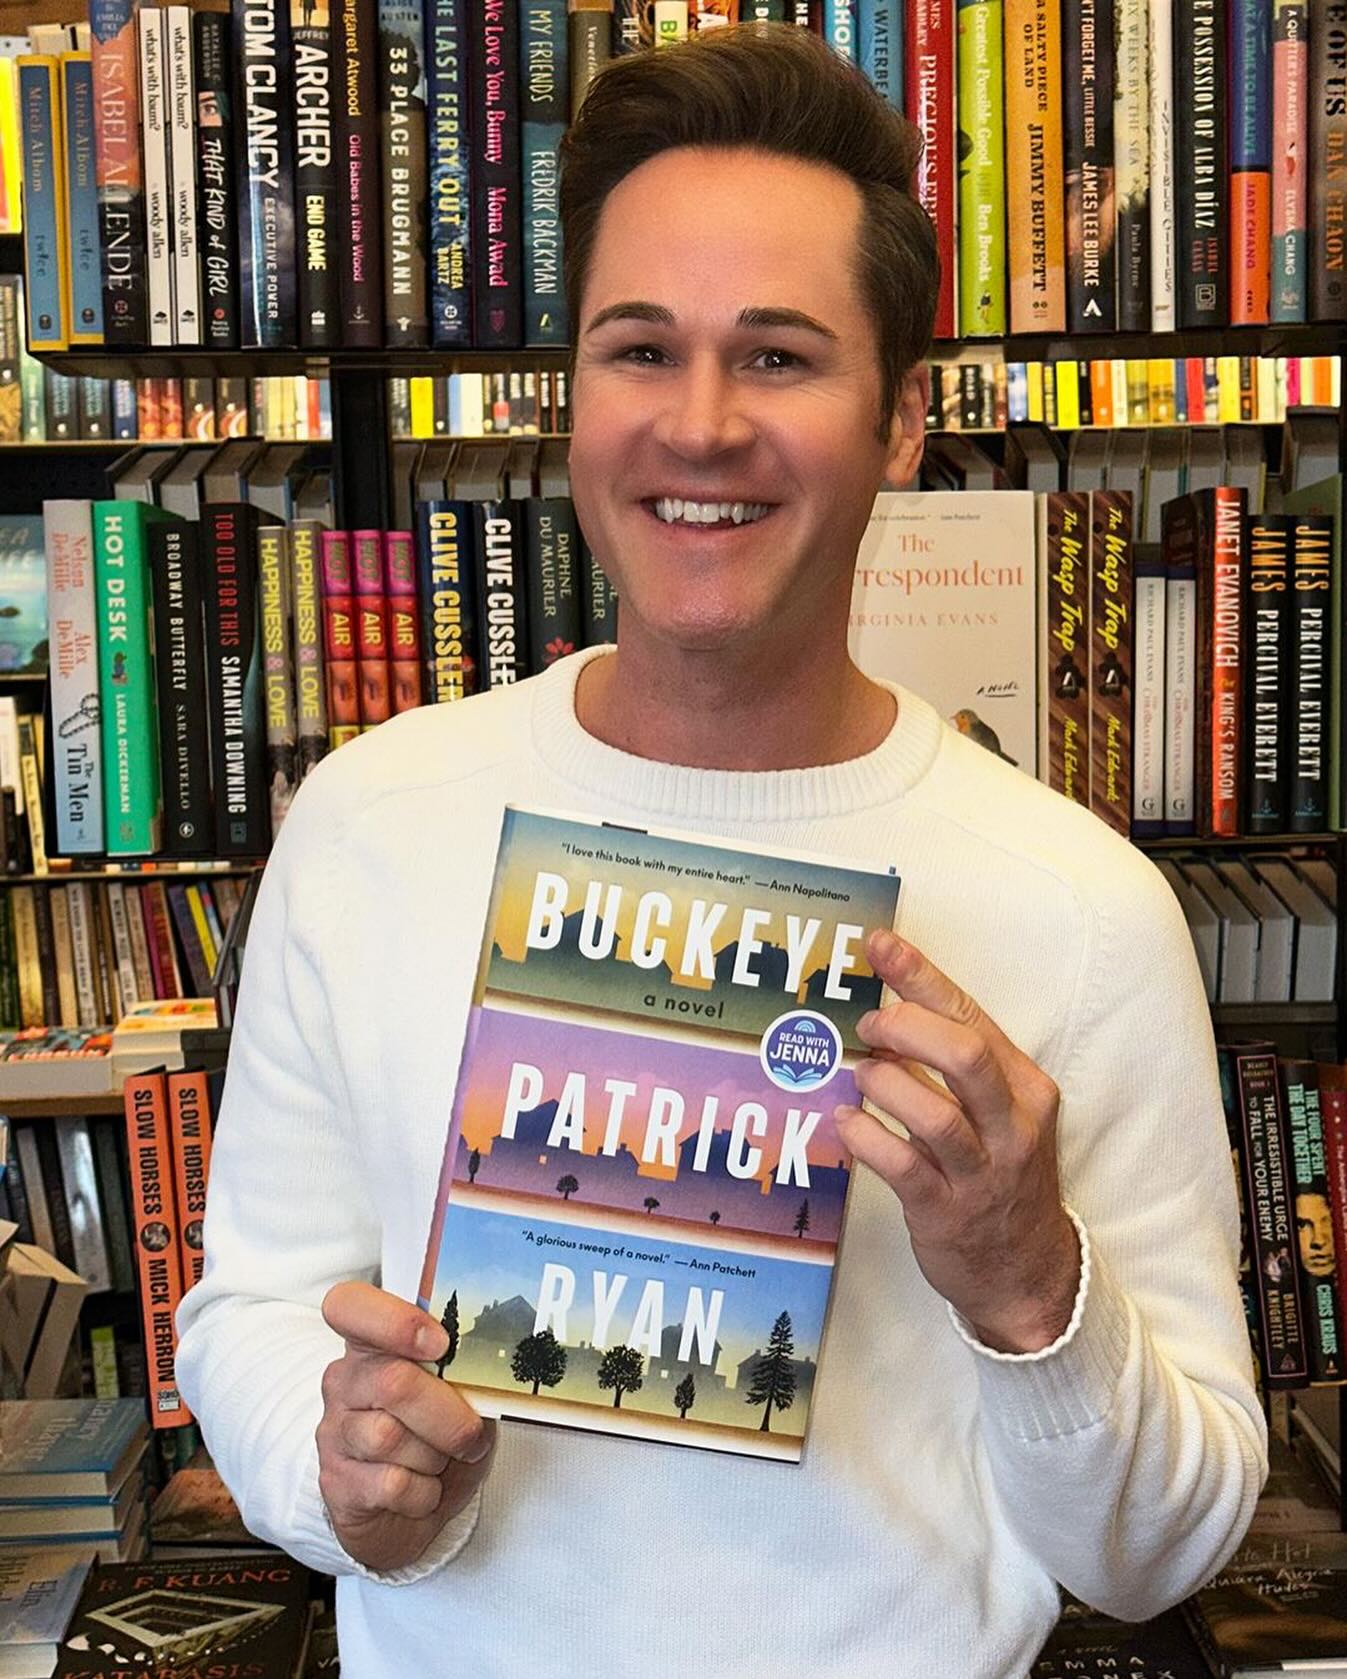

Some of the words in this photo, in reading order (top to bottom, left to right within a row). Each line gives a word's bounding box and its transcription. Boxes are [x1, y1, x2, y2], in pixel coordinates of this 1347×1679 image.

[245, 0, 276, 55] TOM
[484, 26, 504, 66] Love
[529, 10, 552, 39] MY
[1023, 24, 1033, 42] OF
[1037, 14, 1048, 64] SALTY
[1081, 17, 1096, 61] FORGET
[390, 47, 408, 75] 33
[435, 26, 457, 82] LAST
[1024, 47, 1034, 88] LAND
[1194, 15, 1215, 112] POSSESSION
[1326, 29, 1347, 68] OF
[346, 58, 361, 116] Atwood
[484, 71, 505, 106] You,
[528, 42, 554, 103] FRIENDS
[1038, 70, 1048, 112] PIECE
[100, 54, 125, 147] ISABEL
[295, 44, 331, 168] ARCHER
[976, 68, 992, 126] Possible
[1325, 78, 1347, 117] US
[245, 64, 280, 189] CLANCY
[390, 86, 409, 156] PLACE
[437, 93, 459, 174] FERRY
[485, 110, 506, 166] Bunny
[1194, 119, 1215, 143] OF
[202, 138, 223, 186] THAT
[349, 134, 361, 157] Old
[977, 129, 992, 166] Good
[1028, 123, 1044, 196] JIMMY
[1194, 147, 1215, 185] ALBA
[1326, 131, 1345, 180] DAN
[350, 160, 362, 200] Babes
[438, 178, 460, 226] OUT
[531, 151, 556, 212] FREDRIK
[1082, 162, 1099, 210] JAMES
[1245, 184, 1256, 215] JADE
[151, 191, 162, 226] woody
[179, 190, 190, 226] woody
[204, 187, 228, 229] KIND
[306, 195, 326, 227] END
[352, 218, 363, 240] the
[392, 168, 411, 295] BRUGMANN
[487, 187, 507, 234] Mona
[979, 204, 992, 230] Ben
[1083, 213, 1099, 239] LEE
[1194, 191, 1219, 228] DÍAZ
[1326, 188, 1345, 271] CHAON
[152, 229, 162, 258] allen
[180, 228, 190, 258] allen
[264, 197, 278, 270] EXECUTIVE
[307, 229, 327, 271] GAME
[532, 219, 557, 294] BACKMAN
[1031, 200, 1049, 291] BUFFETT
[1131, 223, 1141, 250] Paula
[1245, 218, 1256, 269] CHANG
[1285, 234, 1297, 275] CHANG
[207, 256, 229, 297] GIRL
[352, 243, 364, 282] Wood
[449, 243, 463, 290] ANDREA
[489, 238, 508, 287] Awad
[979, 233, 993, 282] Brooks
[1084, 241, 1100, 287] BURKE
[1131, 252, 1141, 287] Byrne
[267, 275, 279, 319] POWER
[105, 516, 124, 567] HOT
[215, 513, 235, 541] TOO
[539, 517, 553, 539] DU
[1063, 508, 1078, 533] The
[1108, 507, 1123, 531] The
[1216, 500, 1240, 555] JANET
[72, 534, 89, 588] Nelson
[216, 547, 236, 573] OLD
[430, 512, 459, 583] CLIVE
[485, 518, 513, 587] CLIVE
[557, 533, 572, 599] DAPHNE
[898, 533, 935, 553] The
[1052, 536, 1083, 595] Wasp
[1096, 534, 1128, 593] Wasp
[1251, 527, 1287, 592] JAMES
[1295, 525, 1330, 591] JAMES
[166, 533, 184, 608] BROADWAY
[218, 579, 238, 607] FOR
[294, 531, 317, 645] HAPPINESS
[540, 545, 556, 618] MAURIER
[107, 579, 128, 641] DESK
[261, 539, 283, 654] HAPPINESS
[937, 613, 999, 626] EVANS
[1215, 564, 1239, 668] EVANOVICH
[75, 631, 91, 664] Alex
[220, 612, 240, 646] THIS
[333, 612, 351, 645] AIR
[364, 612, 381, 645] AIR
[396, 613, 414, 645] AIR
[433, 590, 464, 702] CUSSLER
[1053, 601, 1083, 652] Trap
[1096, 599, 1128, 649] Trap
[170, 617, 187, 690] BUTTERFLY
[265, 657, 284, 671] &
[299, 648, 317, 662] &
[1256, 609, 1279, 695] PERCIVAL
[1299, 608, 1323, 693] PERCIVAL
[115, 694, 128, 736] LAURA
[221, 655, 244, 736] SAMANTHA
[268, 676, 287, 728] LOVE
[300, 668, 319, 718] LOVE
[1218, 692, 1235, 739] KING'S
[176, 704, 189, 741] SARA
[1063, 715, 1078, 748] Mark
[1107, 712, 1121, 748] Mark
[1255, 702, 1278, 782] EVERETT
[1298, 701, 1321, 780] EVERETT
[67, 743, 87, 775] Tin
[83, 760, 94, 779] The
[117, 738, 131, 813] DICKERMAN
[225, 741, 247, 814] DOWNING
[1218, 743, 1235, 800] RANSOM
[68, 776, 90, 823] Men
[572, 846, 594, 860] love
[595, 849, 614, 863] this
[615, 854, 641, 869] book
[643, 858, 666, 872] with
[668, 865, 684, 878] my
[685, 866, 714, 882] entire
[793, 884, 851, 903] Napolitano
[526, 872, 865, 1001] BUCKEYE
[644, 993, 656, 1007] a
[664, 997, 725, 1019] novel
[770, 1043, 831, 1068] JENNA
[779, 1033, 804, 1047] READ
[805, 1035, 830, 1049] WITH
[134, 1089, 156, 1140] SLOW
[179, 1087, 201, 1138] SLOW
[1264, 1096, 1277, 1119] THE
[1288, 1083, 1305, 1106] THE
[1290, 1107, 1307, 1127] DAY
[1304, 1089, 1319, 1109] THE
[501, 1062, 824, 1188] PATRICK
[1249, 1111, 1263, 1139] FALL
[1307, 1112, 1322, 1140] FOUR
[184, 1144, 206, 1214] HORSES
[1254, 1160, 1269, 1197] YOUR
[1266, 1122, 1286, 1202] IRRESISTIBLE
[1292, 1129, 1313, 1184] TOGETHER
[1311, 1142, 1326, 1176] SPENT
[139, 1147, 162, 1216] HORSES
[1257, 1200, 1275, 1242] ENEMY
[1273, 1204, 1289, 1241] URGE
[535, 1233, 577, 1251] glorious
[578, 1241, 612, 1258] sweep
[613, 1244, 626, 1258] of
[627, 1250, 635, 1259] a
[712, 1262, 756, 1279] Patchett
[148, 1258, 169, 1306] MICK
[1316, 1284, 1333, 1317] CHRIS
[533, 1263, 725, 1366] RYAN
[1266, 1289, 1286, 1349] KNIGHTLEY
[1283, 1293, 1298, 1344] BRIGITTE
[1319, 1319, 1337, 1355] KRAUS
[153, 1310, 176, 1382] HERRON
[165, 1569, 291, 1589] KUANG
